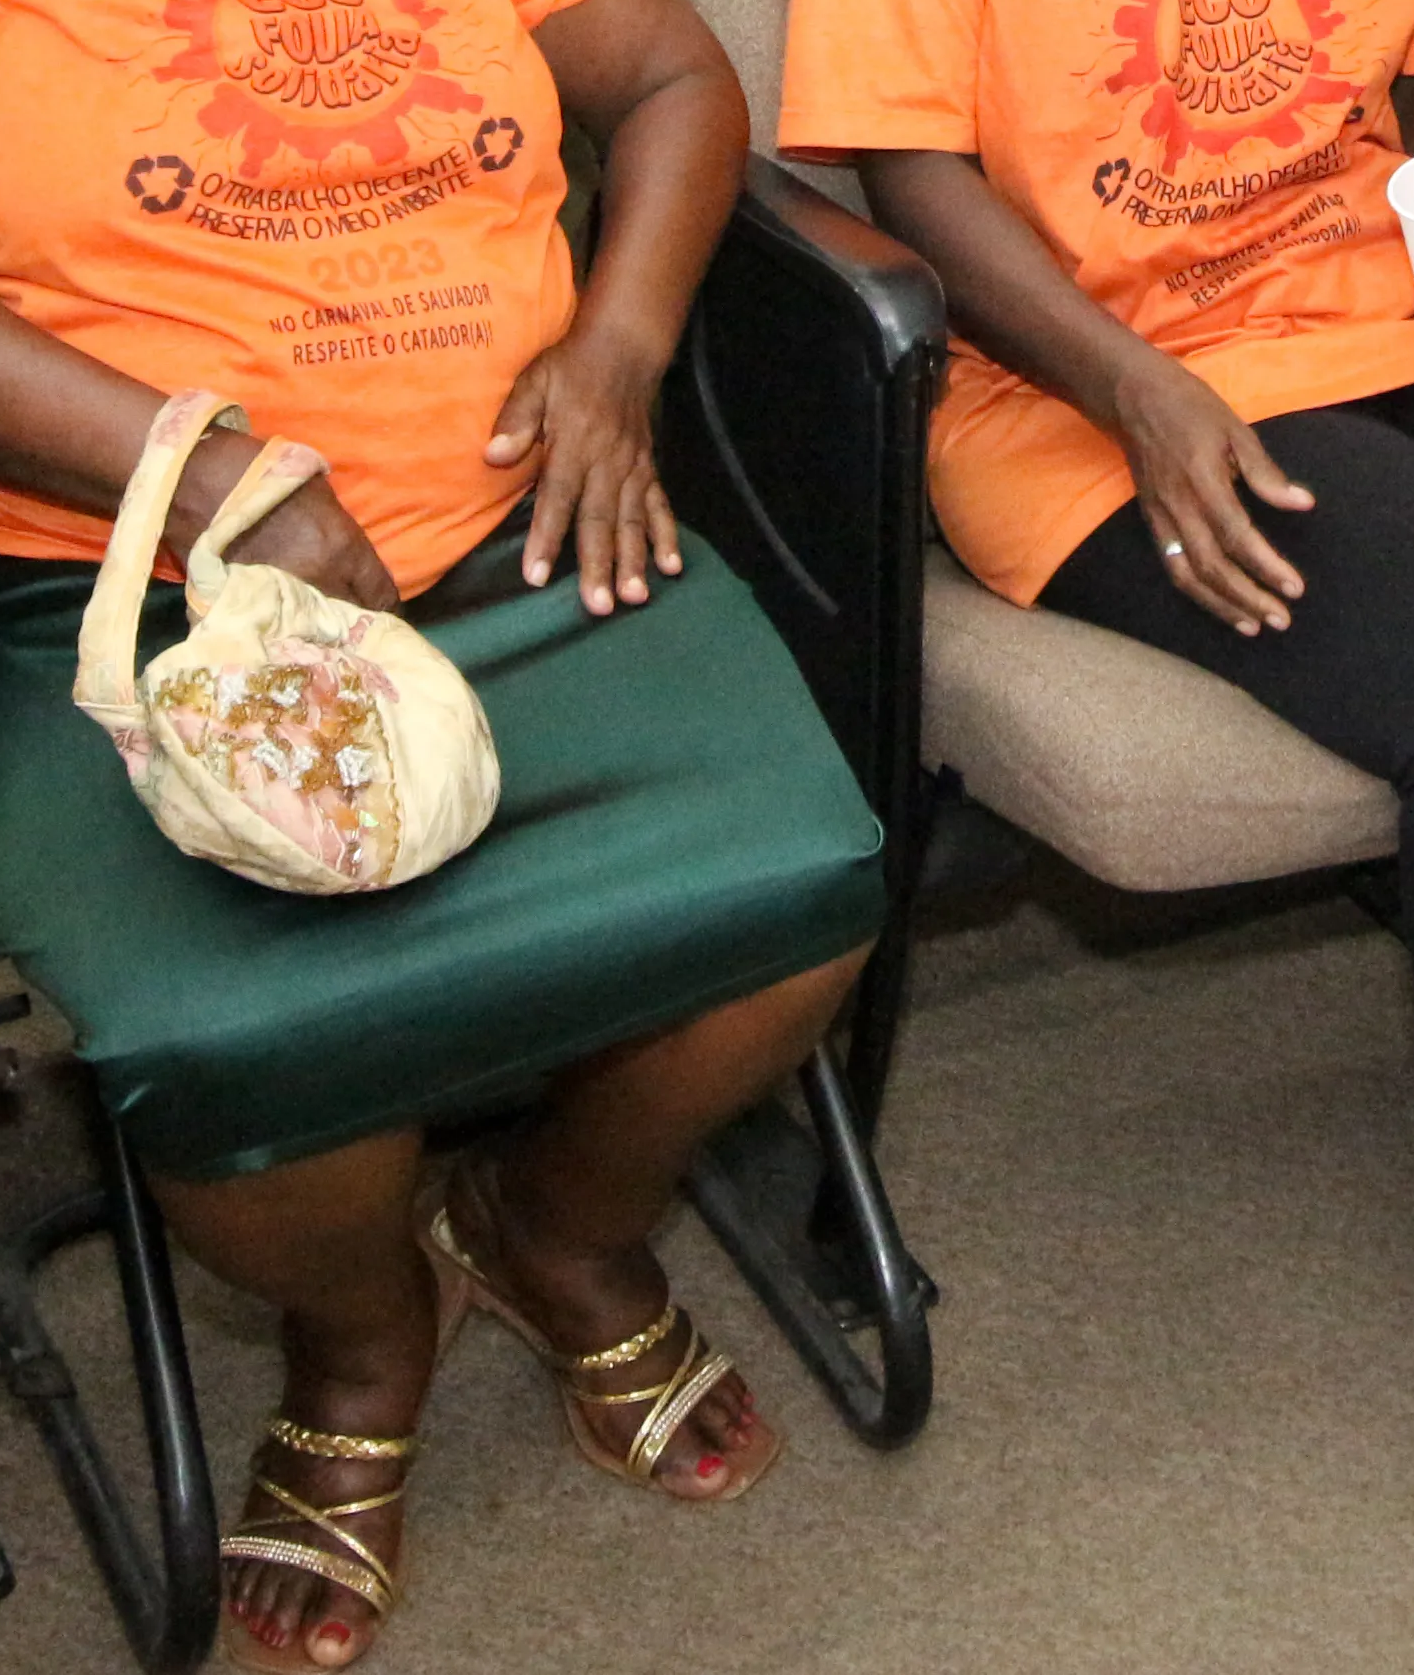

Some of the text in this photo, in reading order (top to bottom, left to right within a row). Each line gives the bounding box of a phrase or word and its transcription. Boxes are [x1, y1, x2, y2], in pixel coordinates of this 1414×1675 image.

[201, 146, 466, 212] O TRABALHO DECENTE
[1135, 168, 1153, 191] O
[1152, 173, 1263, 204] TRABALHO
[186, 203, 299, 242] PRESERVA
[304, 216, 322, 239] O
[326, 208, 380, 238] MEIO
[1121, 195, 1208, 227] PRESERVA
[308, 238, 446, 292] 2023
[1165, 269, 1189, 294] NO
[270, 283, 493, 335] NO CARNAVAL DE SALVADOR
[294, 337, 376, 365] RESPEITE
[384, 334, 395, 355] O
